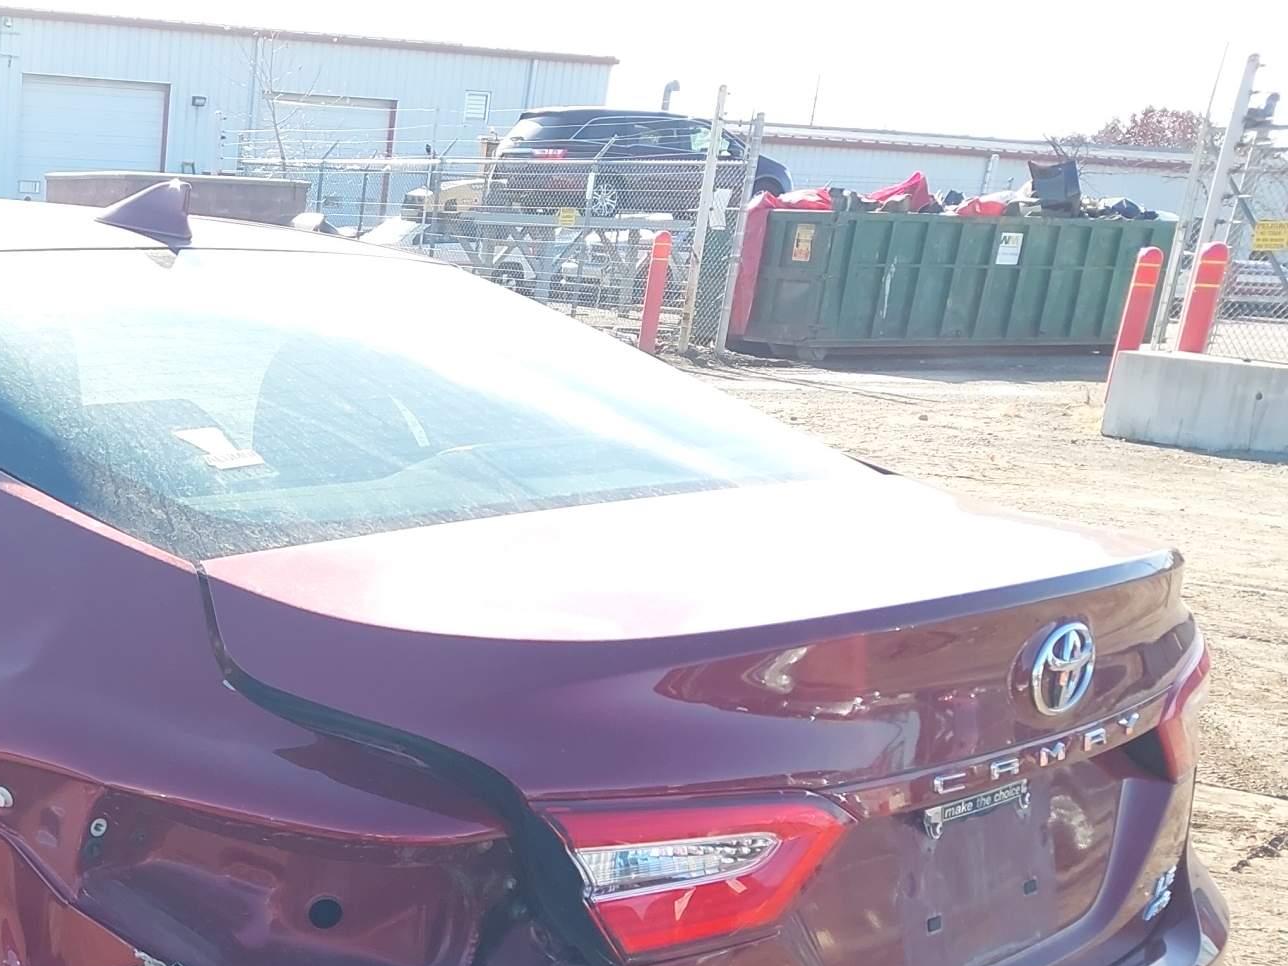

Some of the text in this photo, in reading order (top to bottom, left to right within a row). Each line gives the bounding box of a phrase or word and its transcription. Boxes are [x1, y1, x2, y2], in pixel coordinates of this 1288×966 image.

[933, 712, 1140, 794] CAMRY
[944, 785, 1021, 818] make the choice
